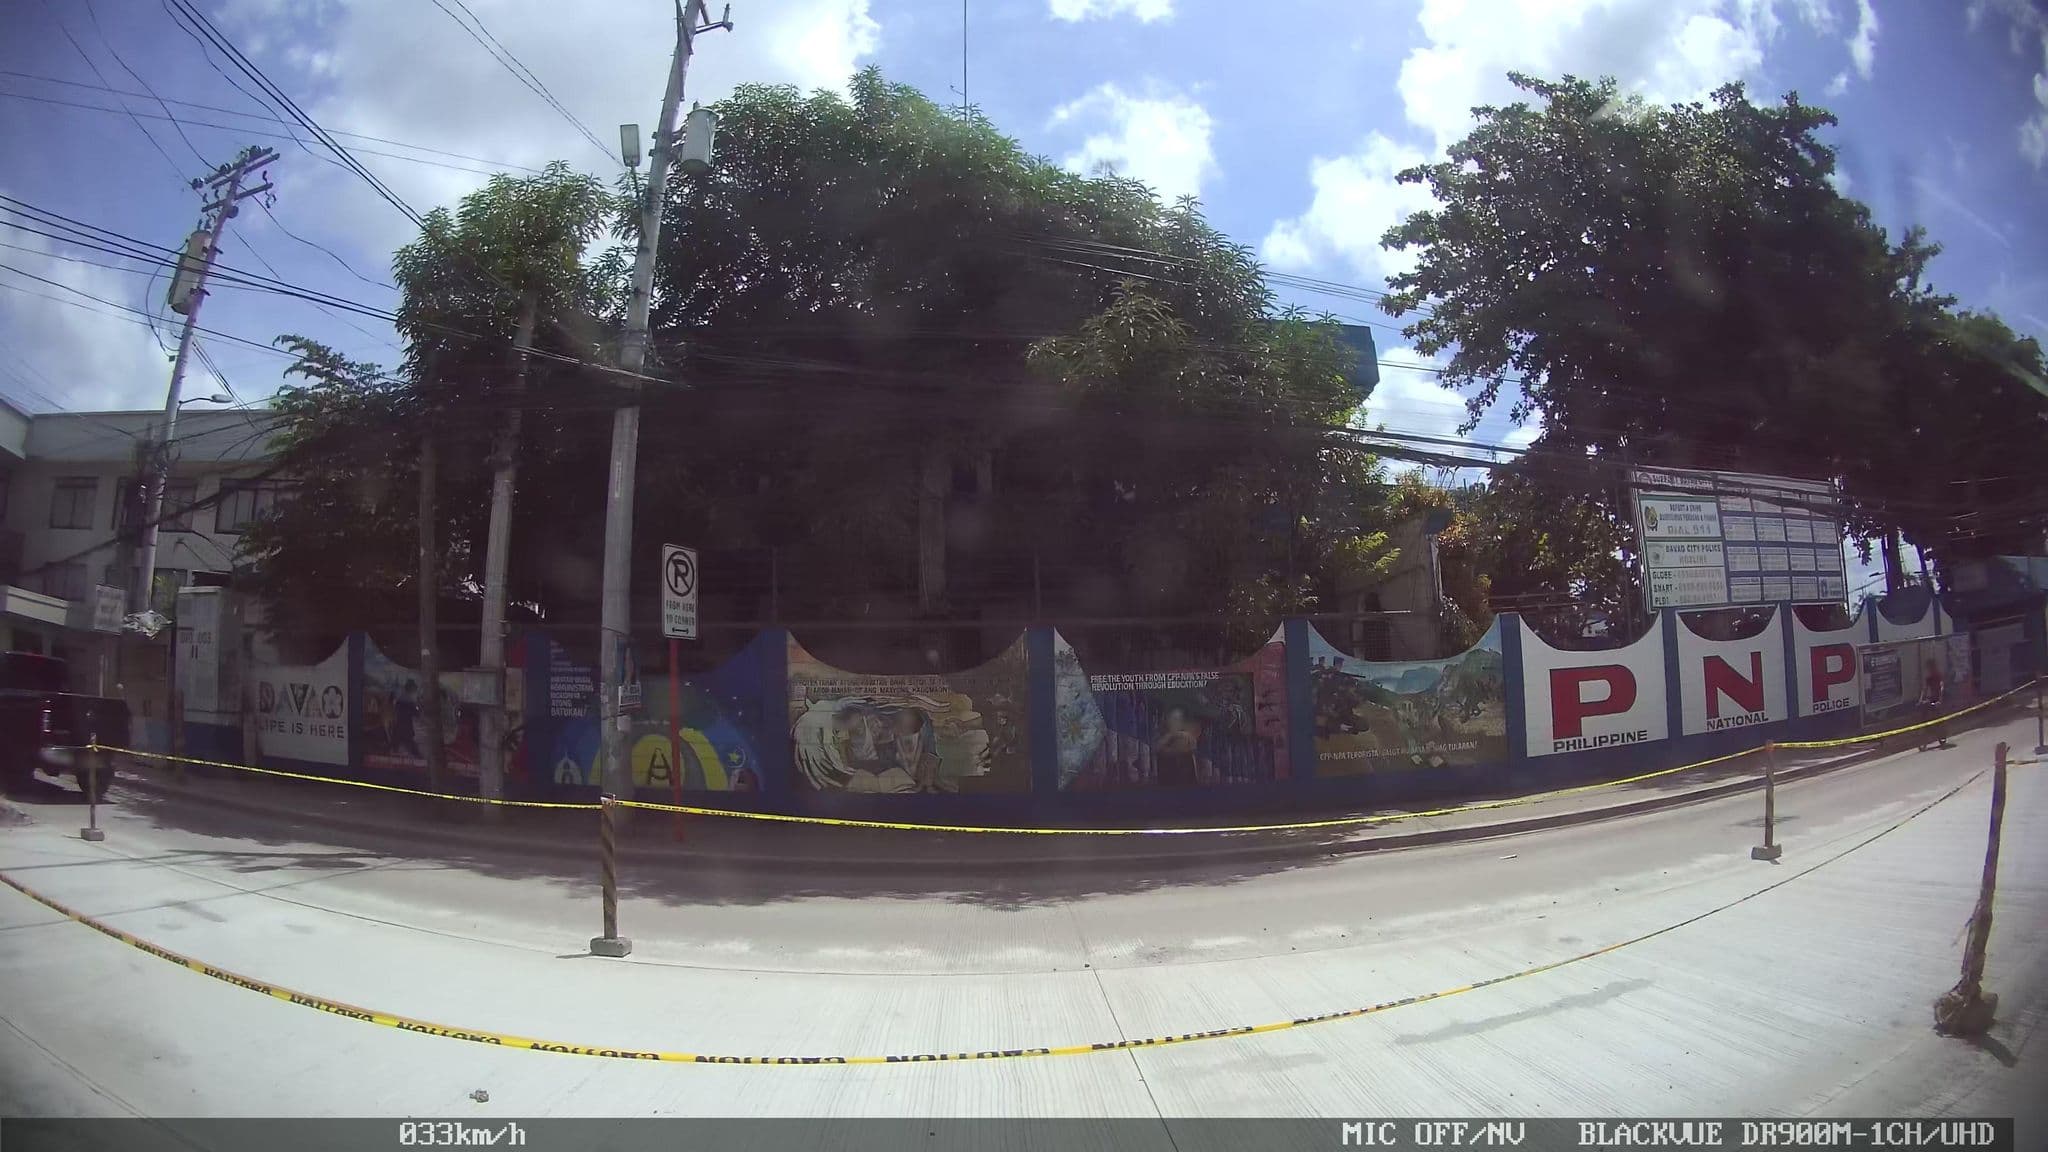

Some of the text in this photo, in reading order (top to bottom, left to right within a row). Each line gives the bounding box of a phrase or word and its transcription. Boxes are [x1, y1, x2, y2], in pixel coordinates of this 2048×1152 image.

[1665, 543, 1721, 553] DAVAO CITY POLICE
[1652, 571, 1672, 579] GLOBE
[1653, 584, 1673, 593] SMART
[1090, 674, 1108, 683] FREE
[1108, 674, 1120, 683] THE
[1120, 673, 1144, 683] YOUTH
[1145, 672, 1166, 682] FROM
[1091, 682, 1135, 692] REVOLUTION
[1135, 680, 1167, 690] THROUGH
[1702, 651, 1765, 720] N
[258, 681, 345, 719] DAVAO
[1549, 664, 1637, 741] P
[1812, 697, 1850, 714] POLICE
[1706, 712, 1769, 731] NATIONAL
[291, 722, 304, 735] IS
[310, 724, 345, 739] HERE
[1553, 730, 1648, 753] PHILIPPINE
